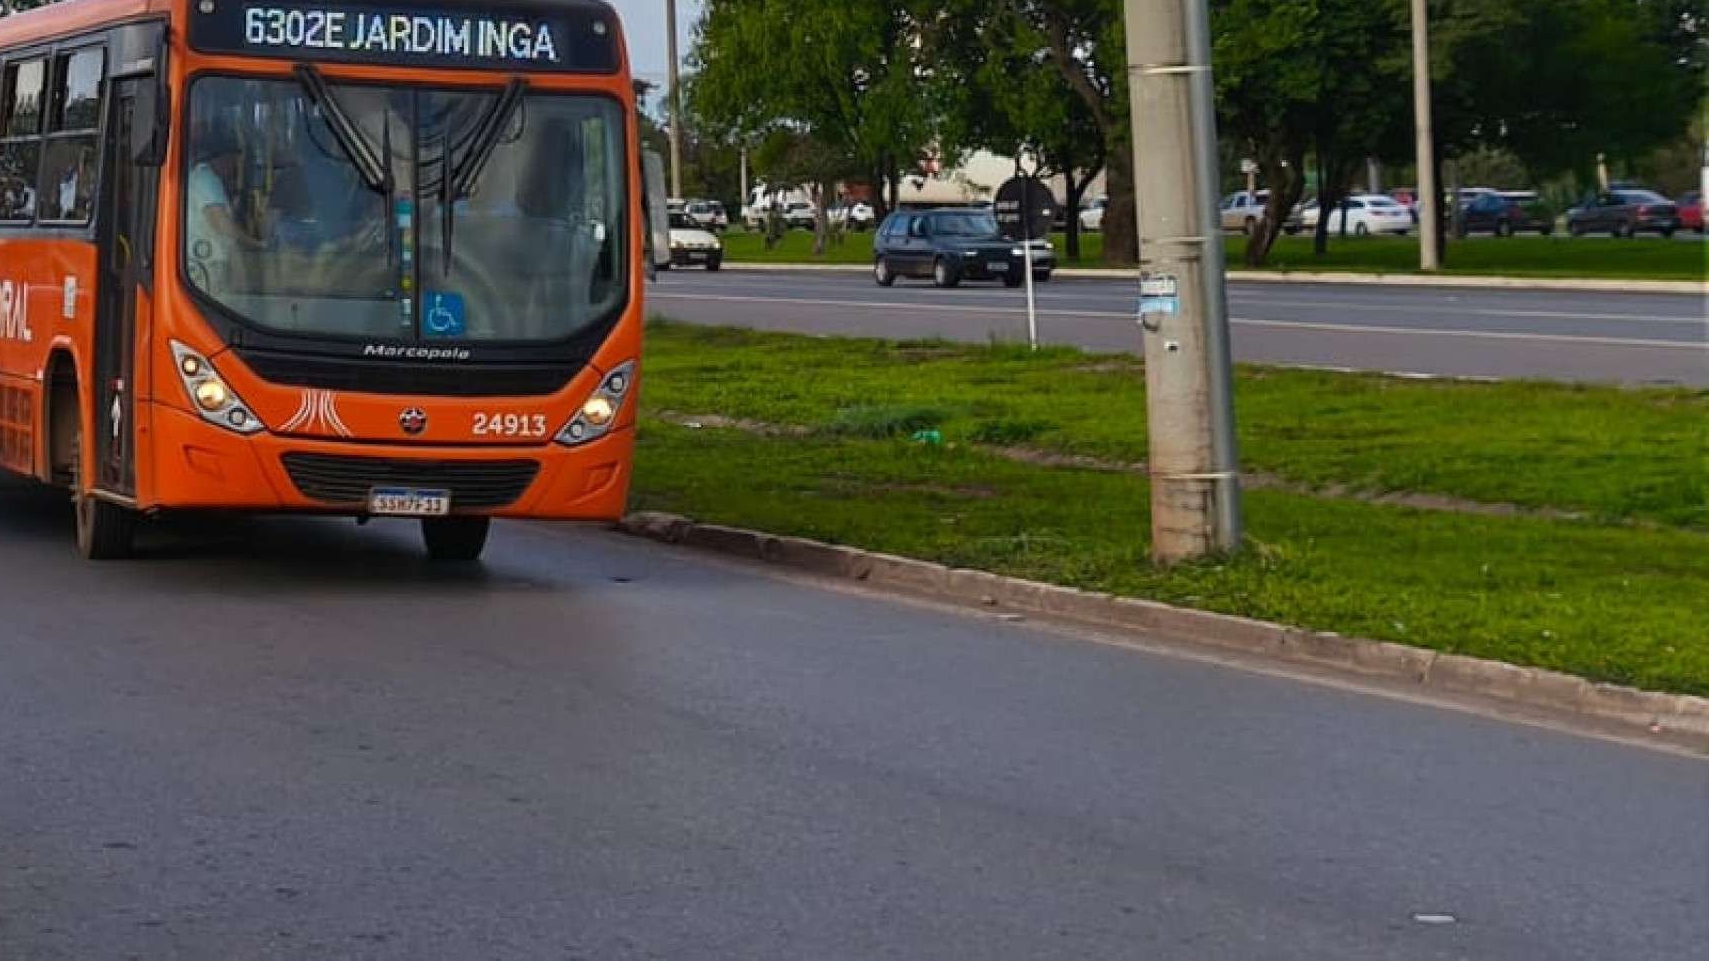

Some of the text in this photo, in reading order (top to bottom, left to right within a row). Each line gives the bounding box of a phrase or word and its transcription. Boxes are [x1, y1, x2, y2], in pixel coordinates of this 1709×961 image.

[245, 7, 560, 62] 6302E JARDIM INGA
[363, 344, 470, 360] Marcopolo
[472, 411, 546, 437] 24913
